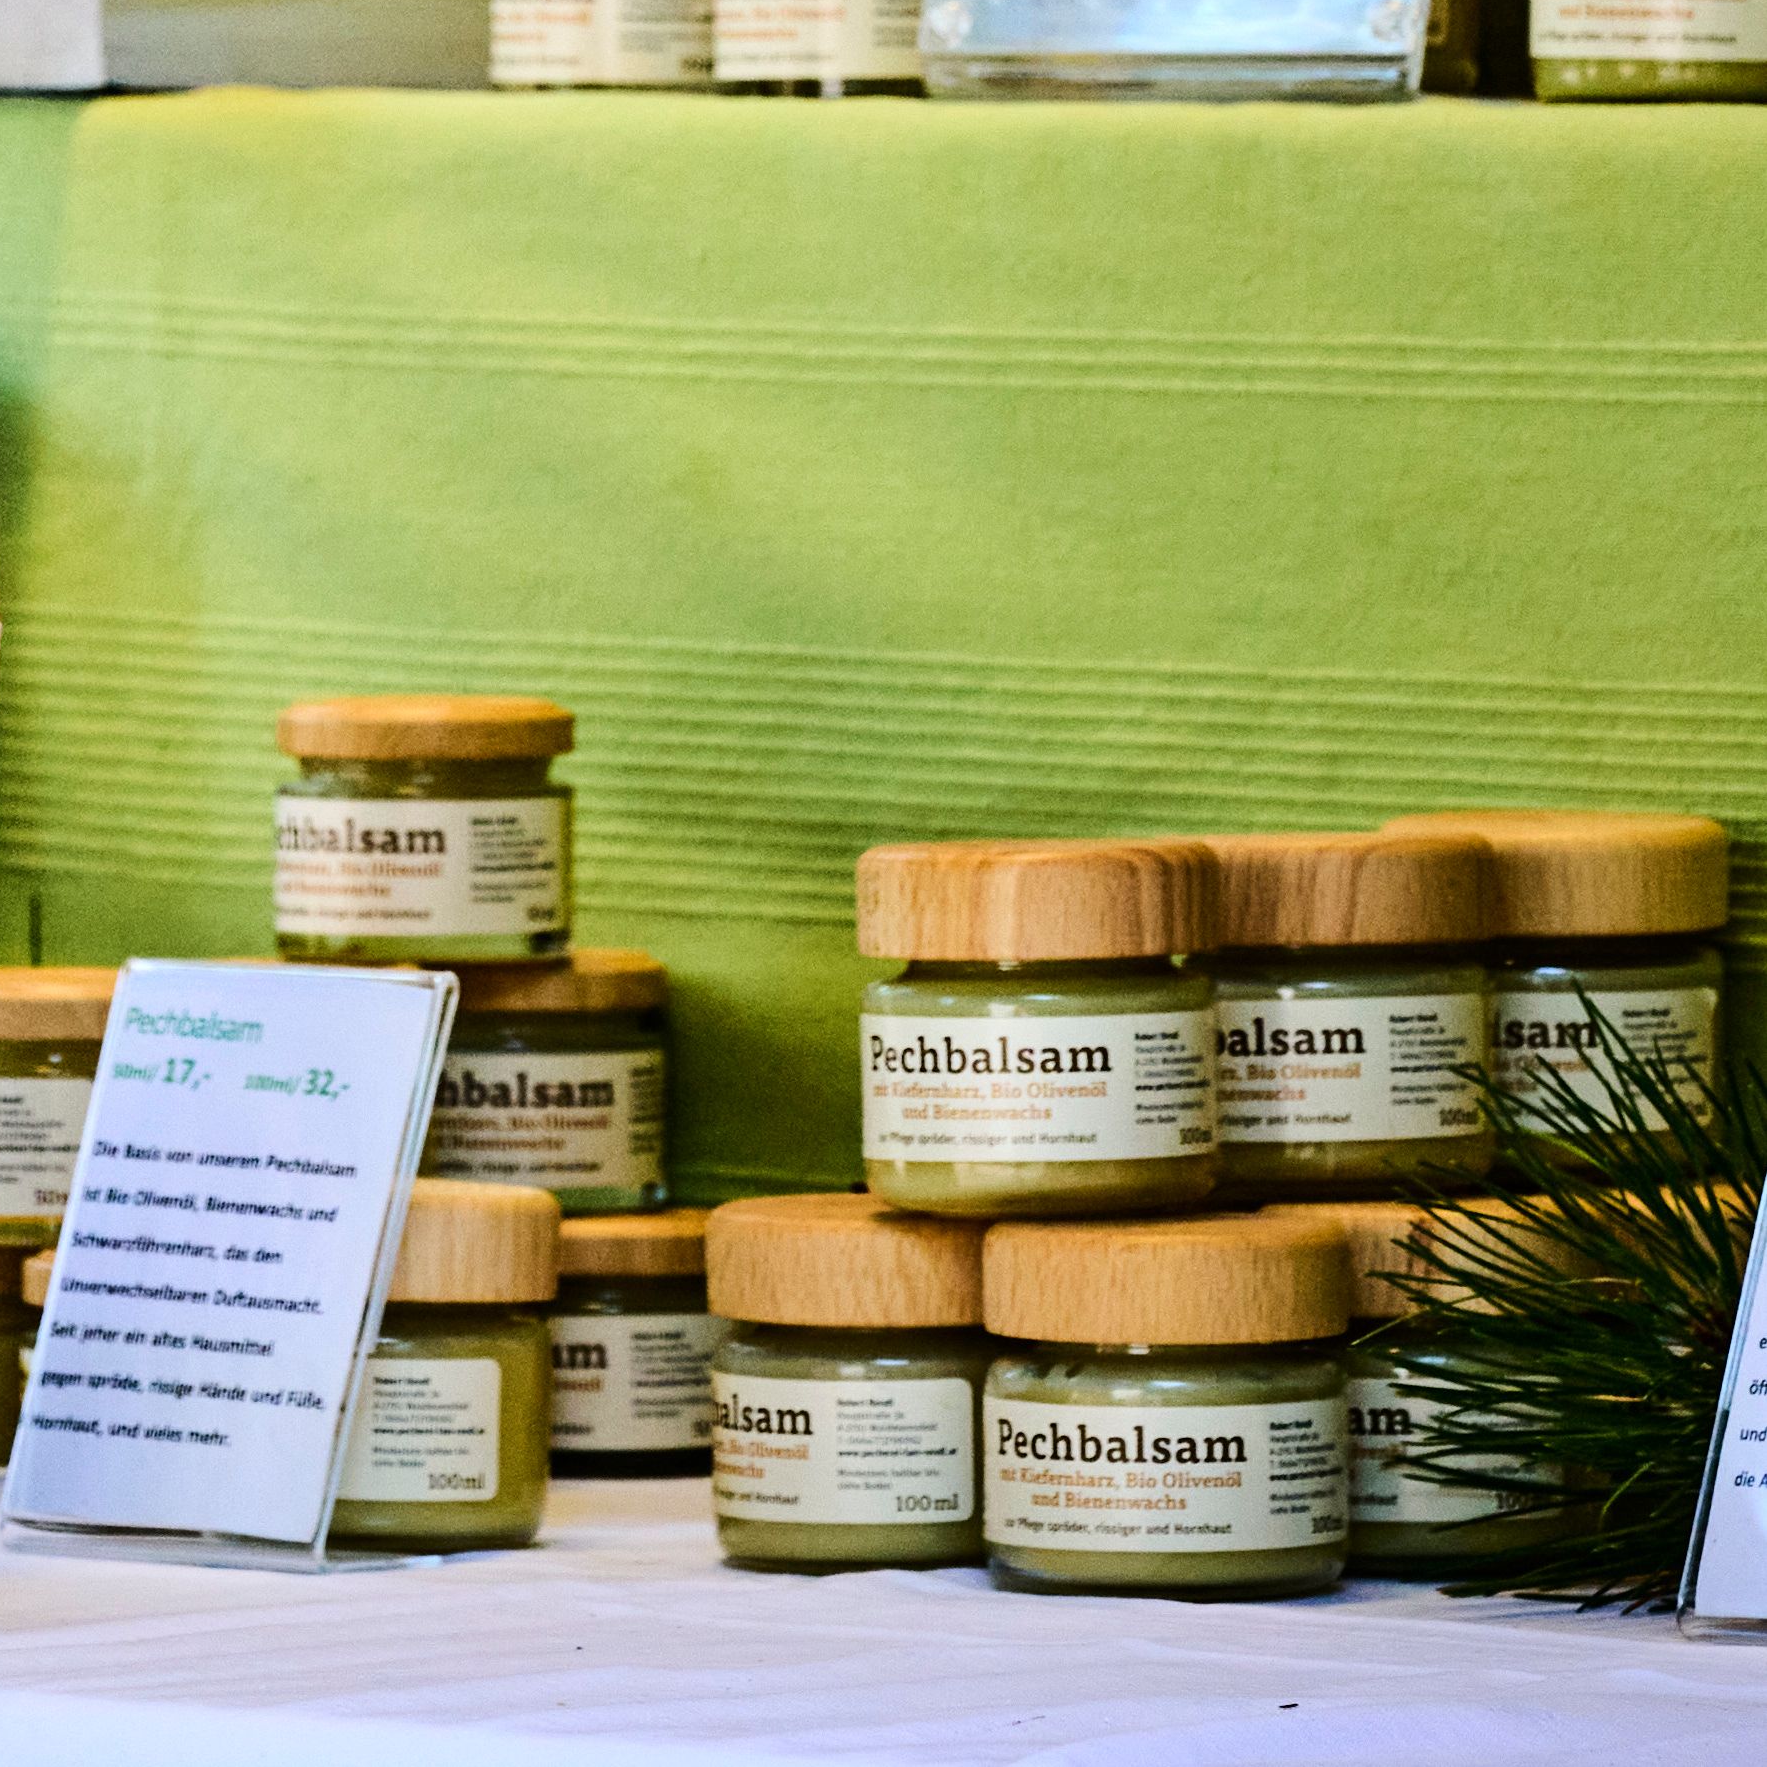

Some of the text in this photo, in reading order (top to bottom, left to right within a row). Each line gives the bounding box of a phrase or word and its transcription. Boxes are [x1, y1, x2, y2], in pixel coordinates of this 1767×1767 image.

[125, 1007, 265, 1043] Pechbalsam
[871, 1035, 1113, 1074] Pechbalsam
[163, 1058, 211, 1091] 17,-
[304, 1068, 350, 1100] 32,-
[991, 1082, 1023, 1098] Bio
[1026, 1080, 1108, 1099] Olivenöl
[902, 1104, 1053, 1121] und Bienenwachs
[197, 1152, 261, 1170] unserem
[264, 1155, 358, 1179] Pechbalsam
[205, 1195, 304, 1219] Bienenwachs
[997, 1419, 1248, 1464] Pechbalsam
[1126, 1473, 1158, 1489] Bio
[1162, 1472, 1243, 1489] Olivenöl
[1734, 1473, 1755, 1487] die
[1031, 1492, 1188, 1511] und Bienenwachs
[1146, 1523, 1170, 1535] und
[1174, 1521, 1233, 1535] Hornhaut
